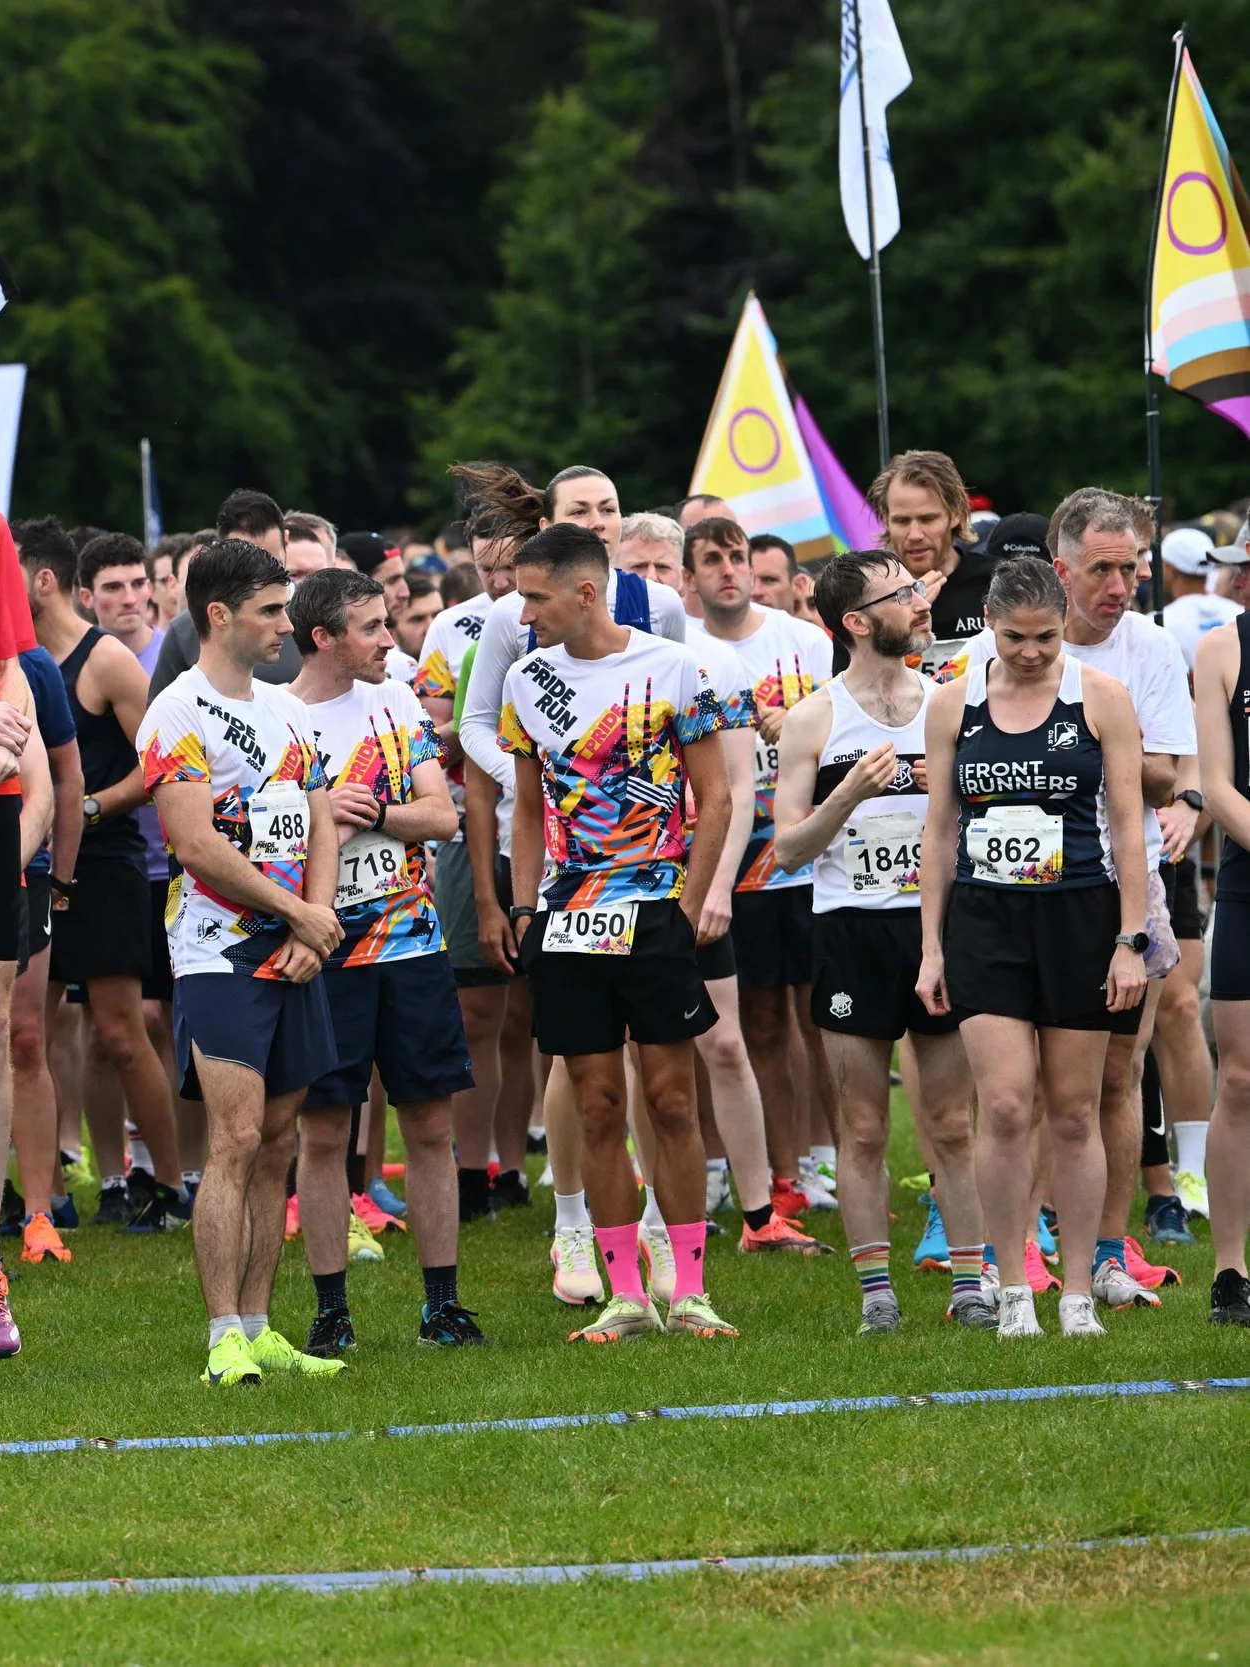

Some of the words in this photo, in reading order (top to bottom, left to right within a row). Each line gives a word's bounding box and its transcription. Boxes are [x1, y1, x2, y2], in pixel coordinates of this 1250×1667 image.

[1008, 543, 1040, 552] Columbia
[535, 656, 557, 672] DUBLIN
[521, 661, 577, 707] PRIDE
[534, 693, 578, 732] RUN
[548, 723, 566, 738] 2024
[584, 702, 623, 755] PRIDE
[223, 725, 267, 768] RUN
[246, 757, 263, 773] 2024
[346, 735, 377, 783] PRIDE
[965, 760, 1044, 779] FRONT
[959, 764, 967, 795] DUBLIN
[965, 775, 1078, 795] RUNNERS
[268, 813, 305, 840] 488
[255, 841, 275, 849] PRIDE
[265, 846, 279, 854] RUN
[986, 837, 1041, 863] 862
[344, 848, 397, 883] 718
[858, 843, 921, 873] 1849
[853, 873, 874, 881] PRIDE
[864, 878, 880, 886] RUN
[347, 888, 364, 897] RUN
[562, 911, 626, 937] 1050
